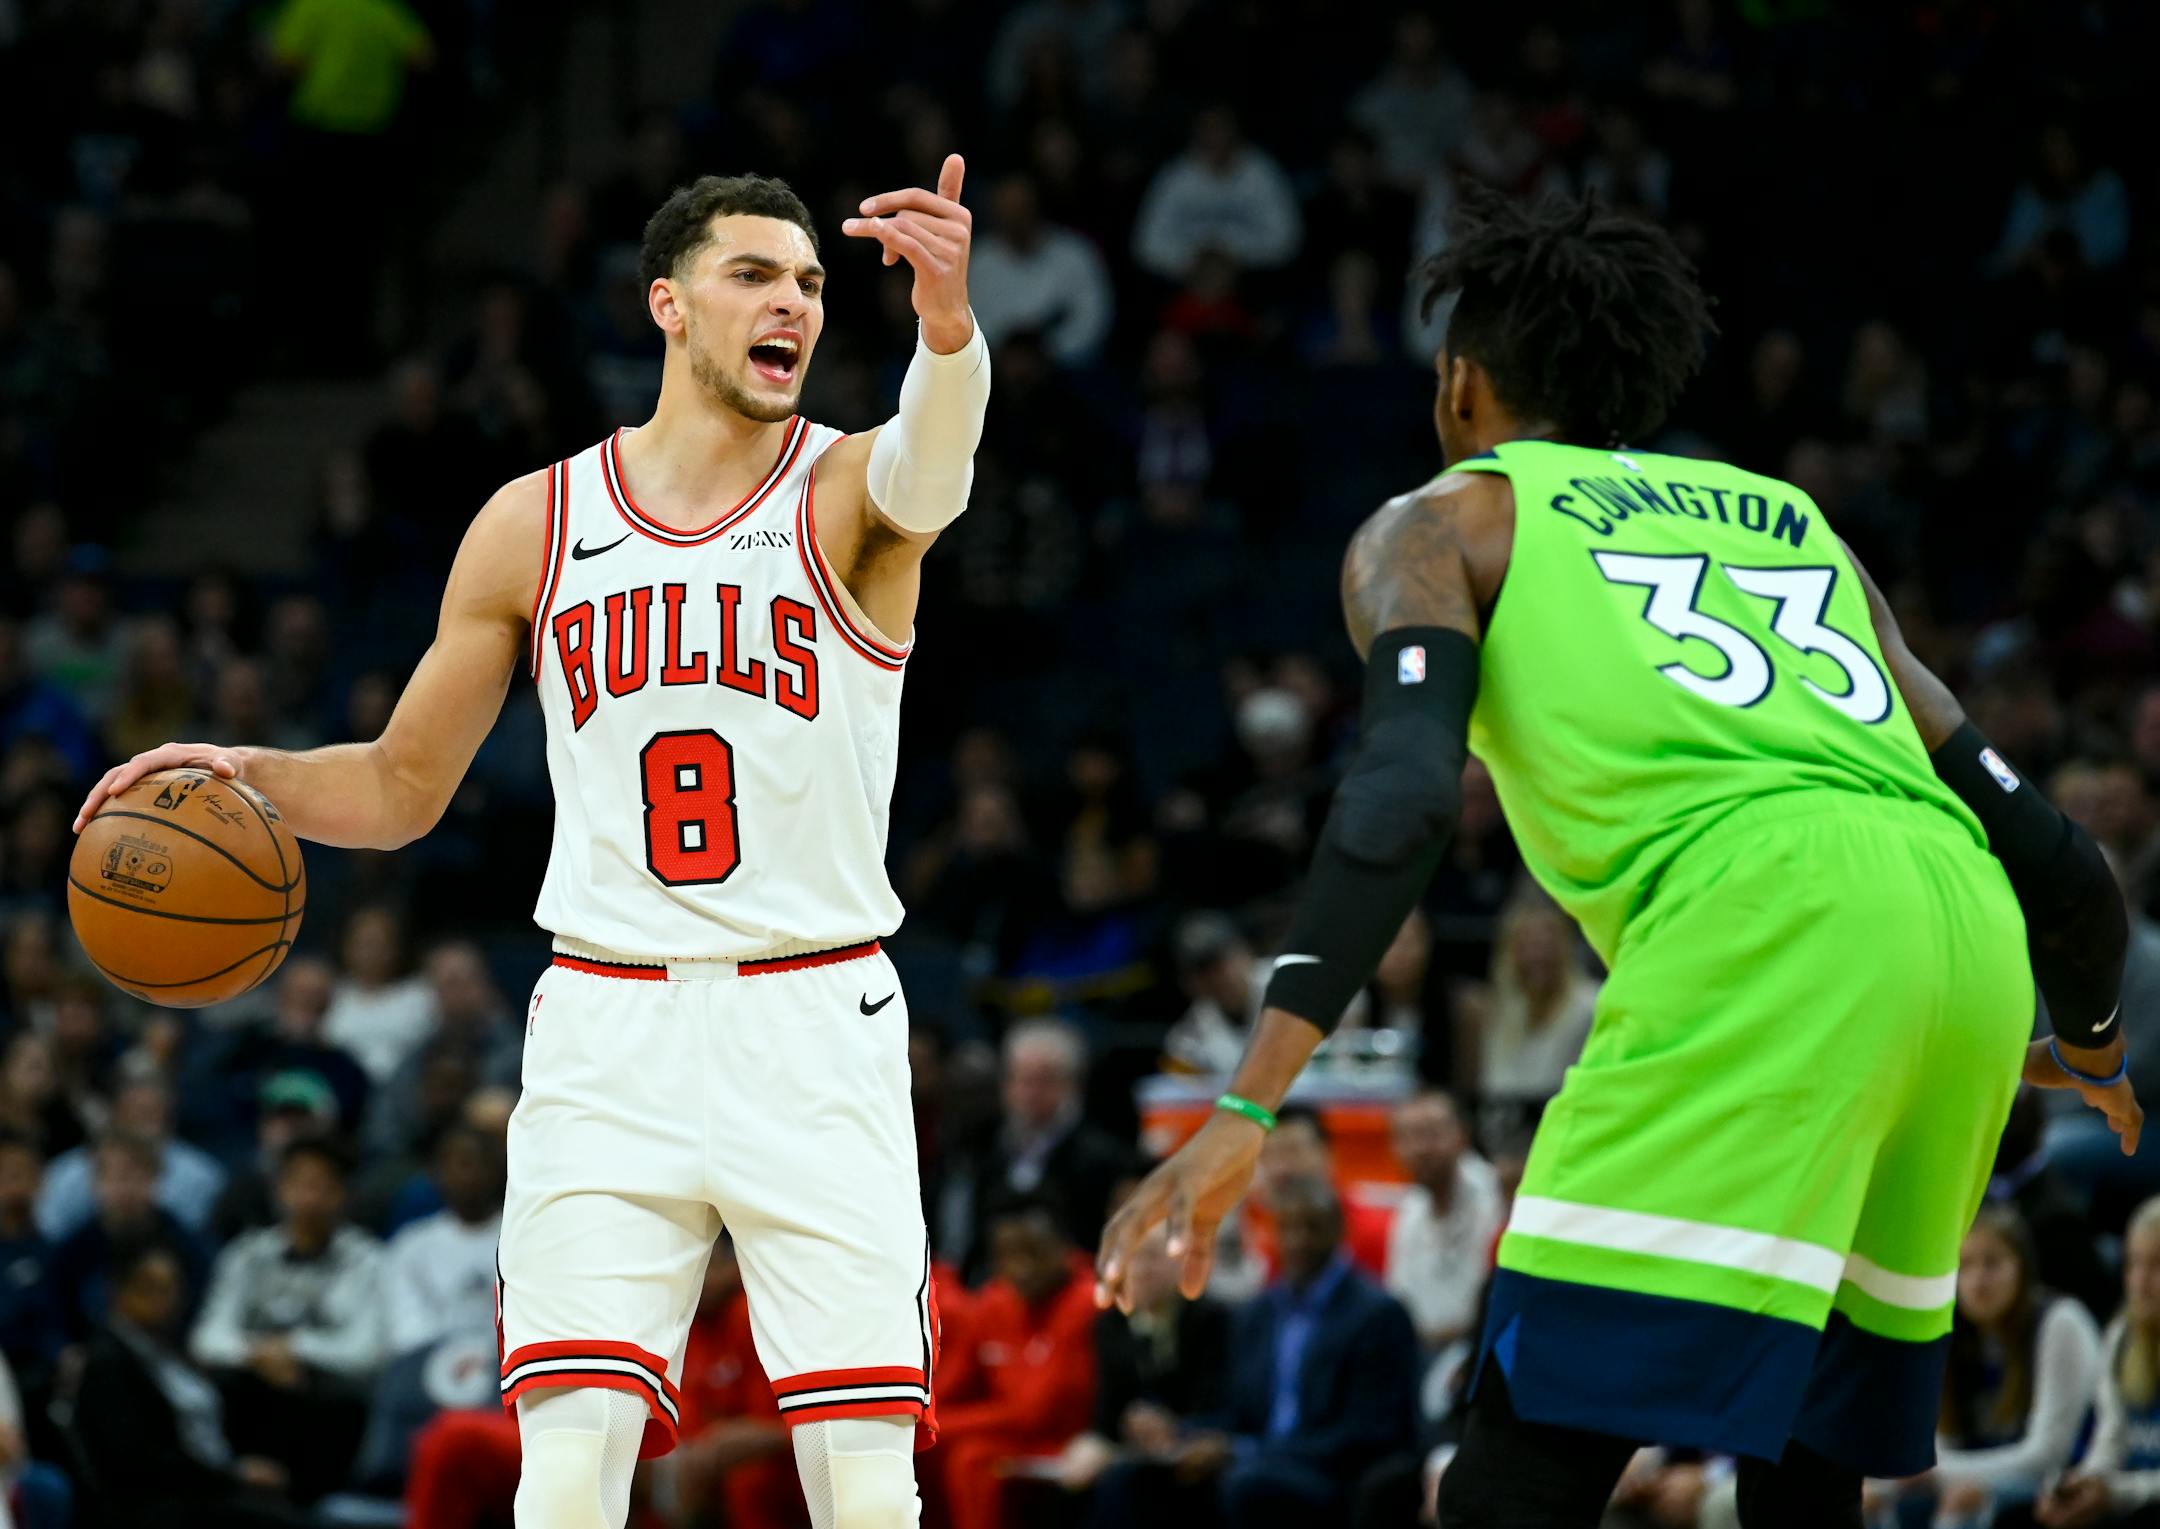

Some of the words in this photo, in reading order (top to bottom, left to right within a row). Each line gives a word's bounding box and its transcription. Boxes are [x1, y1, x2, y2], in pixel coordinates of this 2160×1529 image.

[552, 582, 820, 733] BULLS
[1588, 548, 1893, 726] 33
[639, 728, 742, 888] 8
